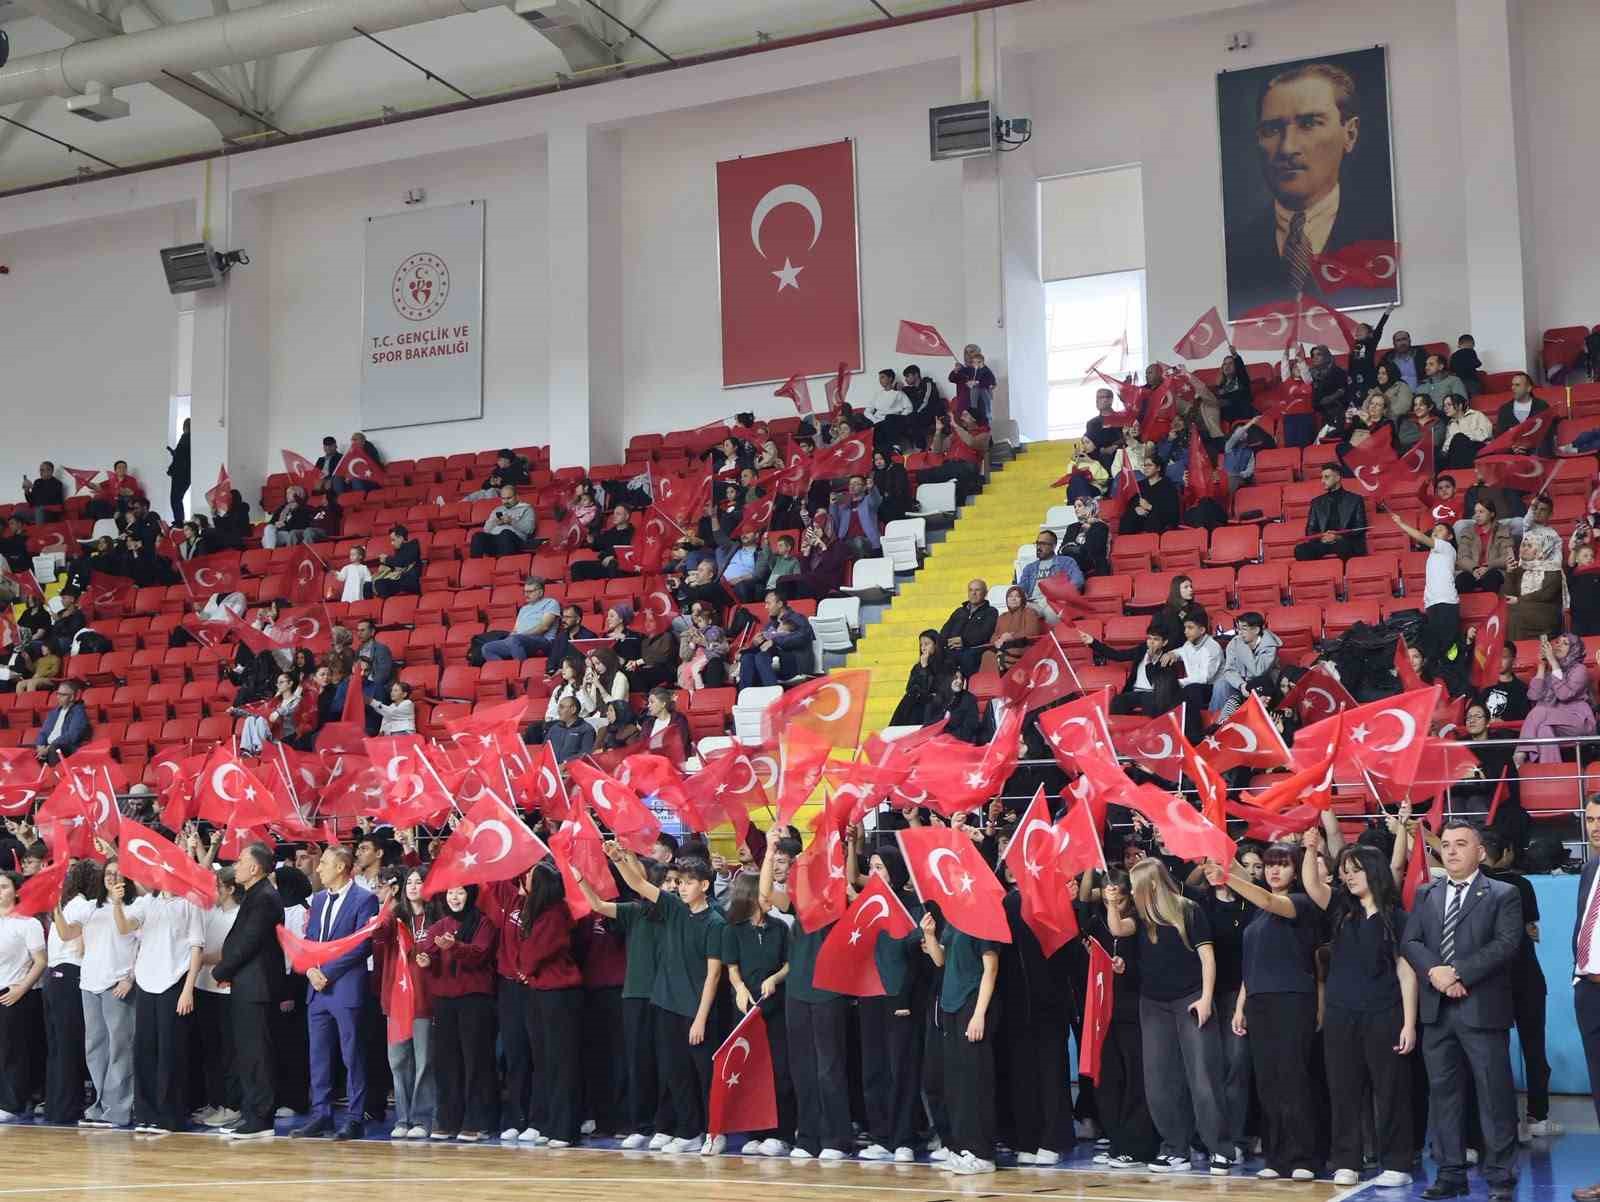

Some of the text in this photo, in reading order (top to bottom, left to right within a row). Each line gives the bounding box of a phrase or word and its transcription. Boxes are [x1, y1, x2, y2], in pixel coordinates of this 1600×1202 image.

[372, 325, 469, 348] T.C. GENÇLİK VE
[372, 341, 469, 364] SPOR BAKANLIĞI
